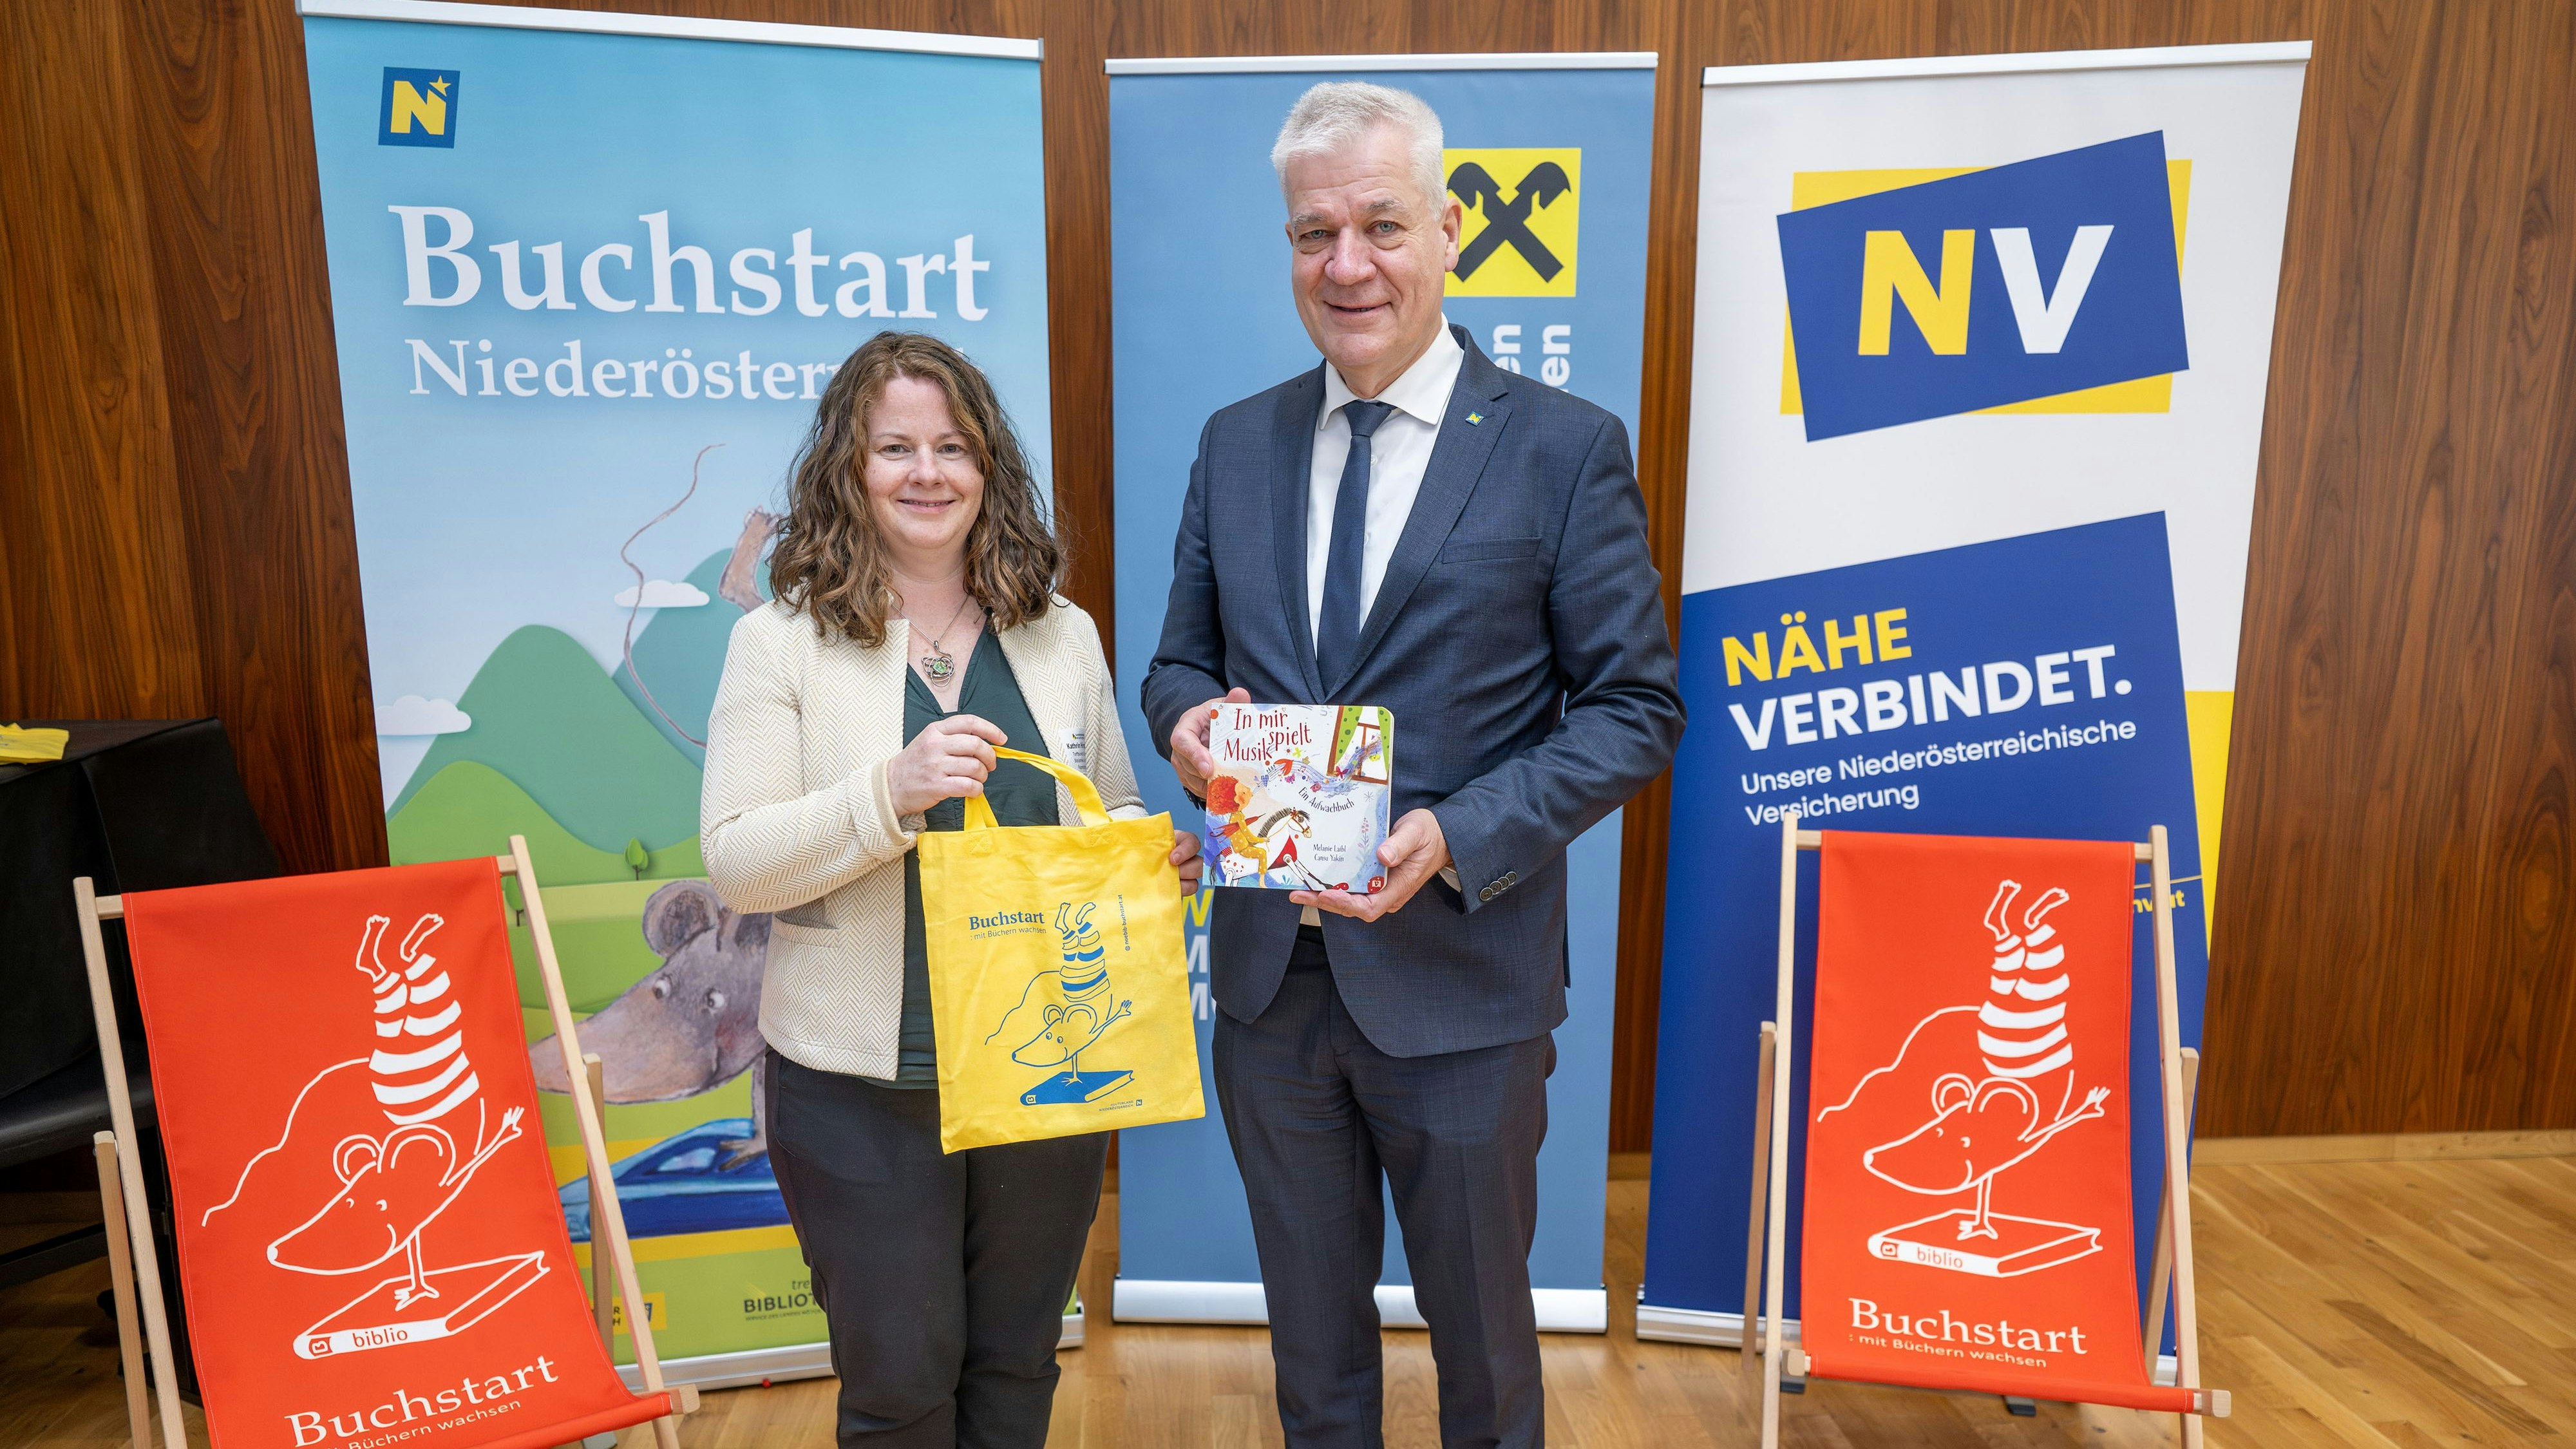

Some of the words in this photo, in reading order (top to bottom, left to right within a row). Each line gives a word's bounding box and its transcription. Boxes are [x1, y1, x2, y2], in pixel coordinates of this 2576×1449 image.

[388, 205, 990, 321] Buchstart
[1722, 608, 1912, 687] NÄHE
[1728, 645, 2132, 752] VERBINDET.
[1235, 708, 1252, 730] In
[1260, 710, 1288, 728] mir
[1224, 738, 1273, 762] Musik
[1269, 723, 1312, 751] spielt
[1741, 762, 1832, 795] Unsere
[1839, 719, 2137, 781] Niederösterreichische
[1298, 786, 1309, 801] Ein
[1309, 797, 1354, 813] Aufwachbuch
[1745, 782, 1920, 826] Versicherung
[1312, 844, 1332, 852] Melanie
[1334, 844, 1347, 853] Laibl
[1314, 853, 1329, 862] Cansu
[1330, 854, 1344, 862] Yakin
[969, 911, 1045, 931] Buchstart
[974, 932, 986, 940] mit
[988, 927, 1016, 938] Büchern
[1917, 1247, 1964, 1269] biblio
[352, 1329, 408, 1348] biblio
[1848, 1298, 2088, 1354] Buchstart
[1859, 1336, 1888, 1348] mit
[1893, 1338, 1964, 1358] Büchern
[1969, 1351, 2047, 1368] wachsen
[284, 1355, 560, 1448] Buchstart
[348, 1424, 432, 1449] Büchern
[437, 1399, 522, 1431] wachsen
